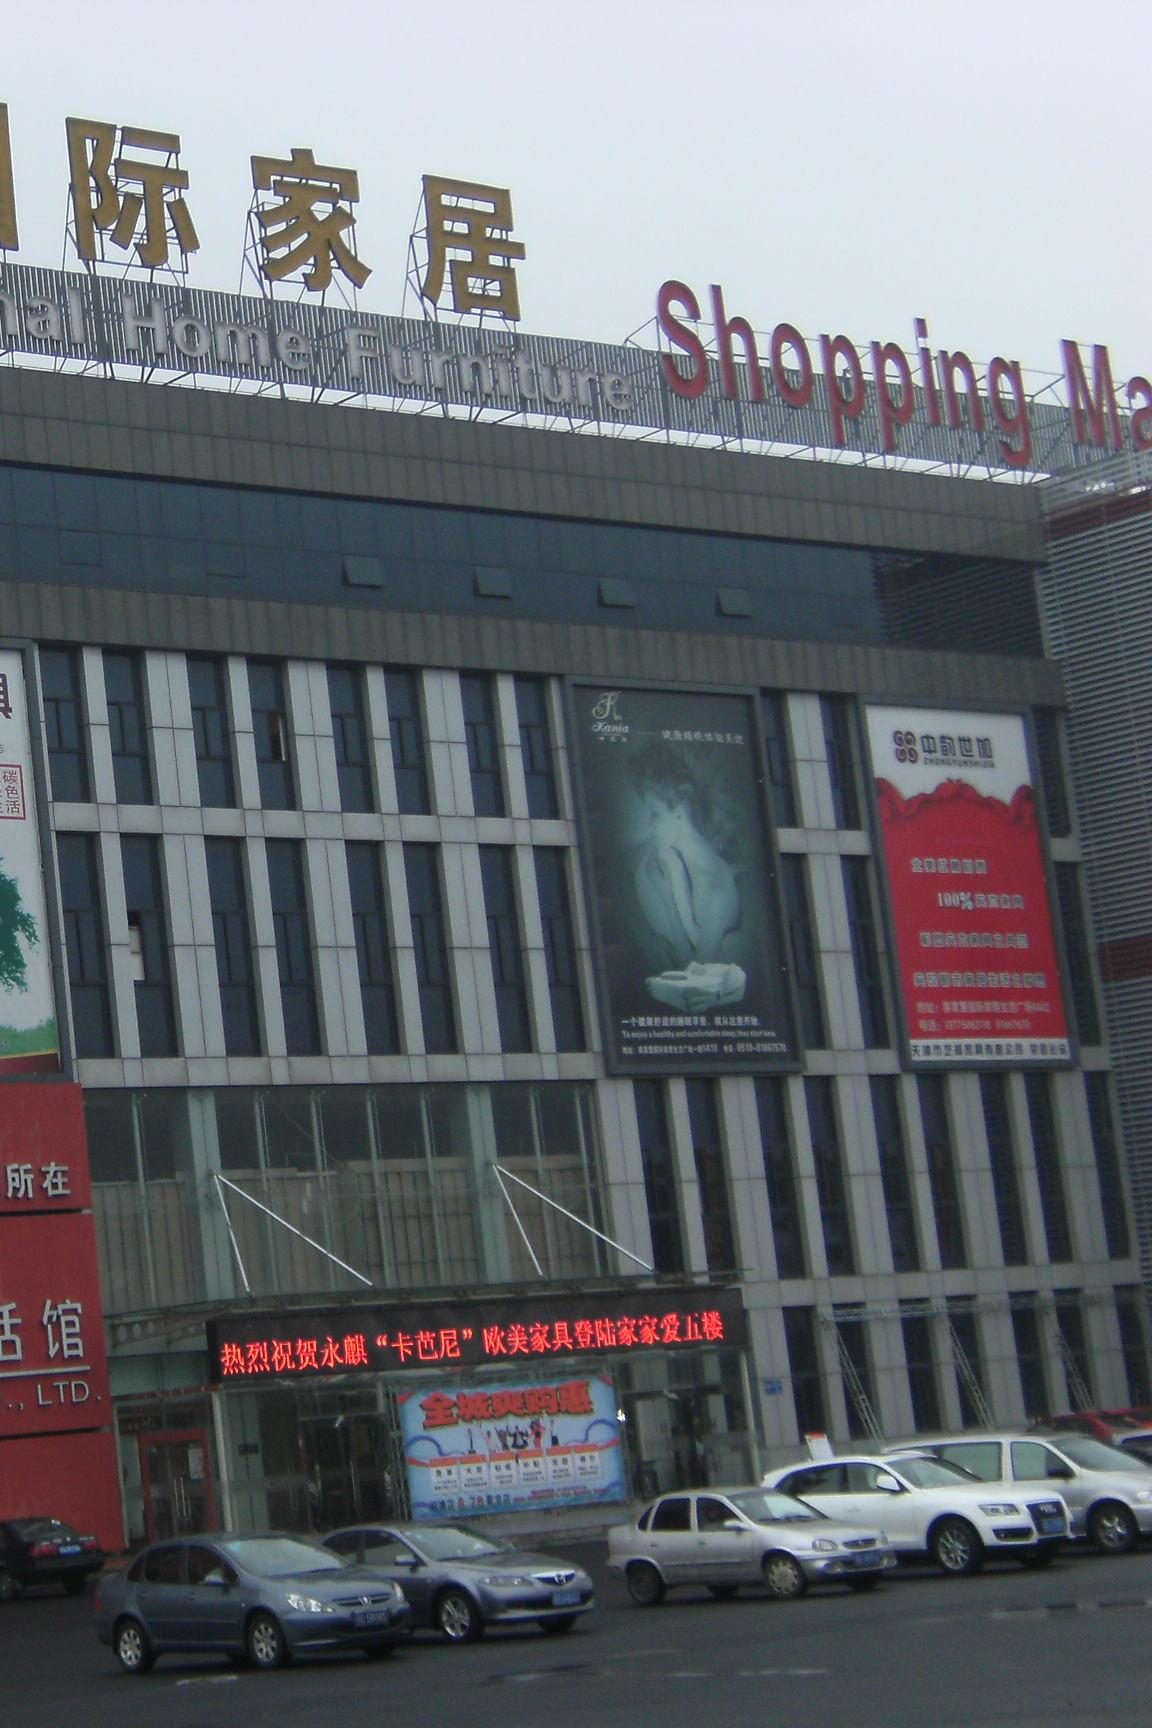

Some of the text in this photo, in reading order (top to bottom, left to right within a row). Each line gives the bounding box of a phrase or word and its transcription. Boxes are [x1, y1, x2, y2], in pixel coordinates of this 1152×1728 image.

[123, 291, 315, 373] Home
[340, 322, 634, 412] Furniture
[656, 279, 1033, 467] Shopping
